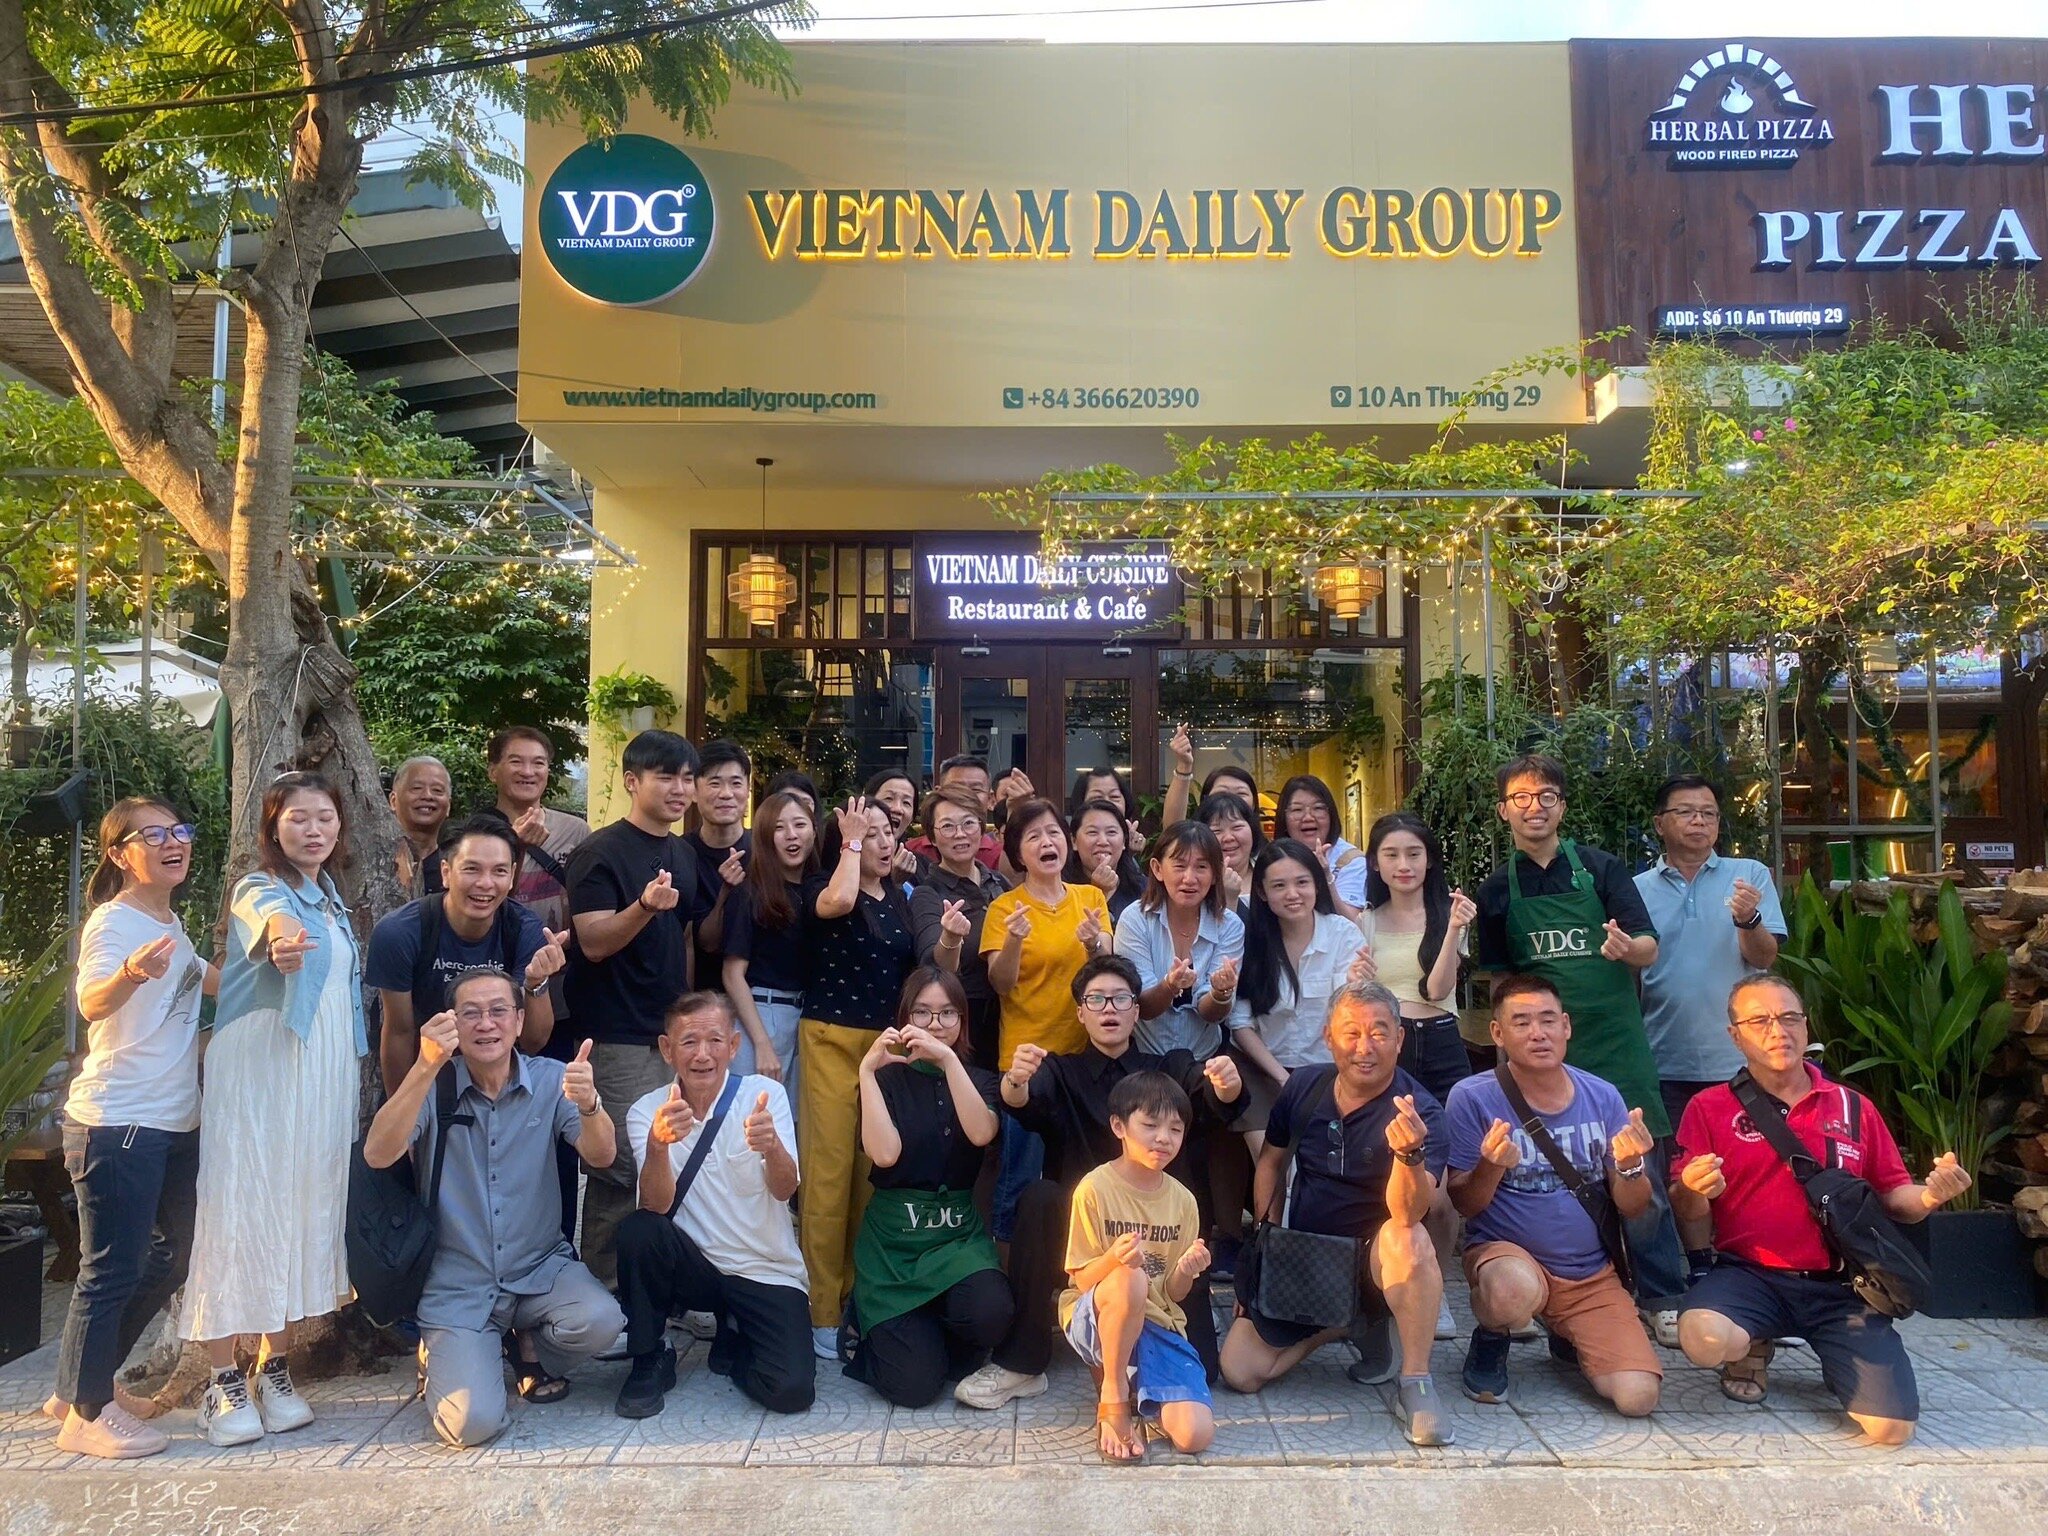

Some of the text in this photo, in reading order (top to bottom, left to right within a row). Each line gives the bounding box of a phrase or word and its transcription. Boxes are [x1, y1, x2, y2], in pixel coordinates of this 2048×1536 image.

[1650, 118, 1834, 142] HERBAL PIZZA
[1878, 84, 2046, 156] HE
[1676, 148, 1799, 161] WOOD FIRED PIZZA
[557, 189, 688, 237] VDG
[747, 185, 1563, 259] VIETNAM DAILY GROUP
[557, 237, 696, 249] VIETNAM DAILY GROUP
[1758, 208, 2043, 264] PIZZA
[1665, 310, 1699, 326] ADD:
[1702, 307, 1722, 326] Số
[1725, 311, 1743, 326] 10
[1746, 310, 1765, 325] An
[1824, 307, 1843, 323] 29
[562, 386, 877, 413] www.vietnamdailygroup.com
[1358, 385, 1386, 408] 10
[1389, 386, 1421, 408] An
[1513, 385, 1541, 407] 29
[926, 554, 1019, 584] VIETNAM
[947, 595, 1147, 620] Restaurant & Cafe
[1527, 927, 1588, 954] VDG
[1149, 1224, 1181, 1243] HOME
